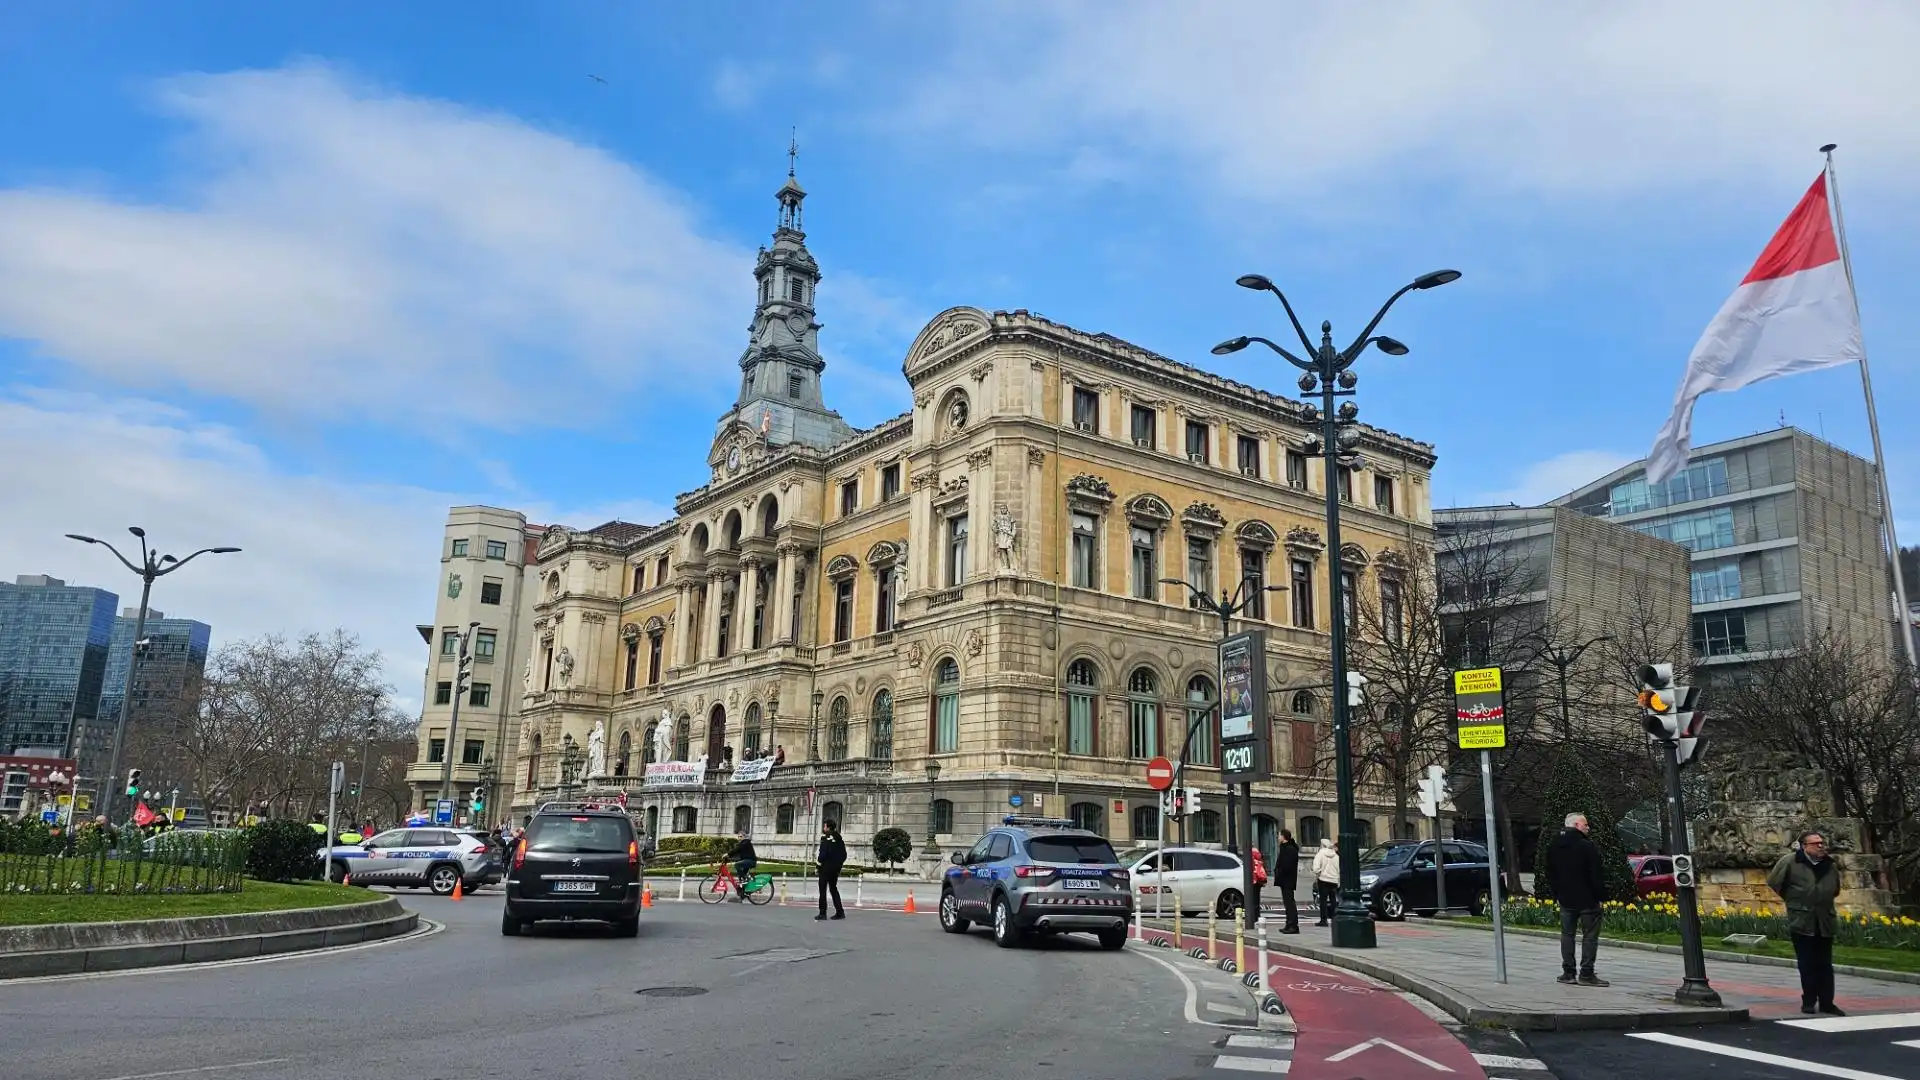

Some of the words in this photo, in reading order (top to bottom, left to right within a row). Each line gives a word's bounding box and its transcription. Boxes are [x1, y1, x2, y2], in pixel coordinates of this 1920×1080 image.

[1461, 671, 1493, 680] KONTUZ
[1460, 682, 1498, 691] ATENCIÓN
[1226, 746, 1250, 770] 12:10
